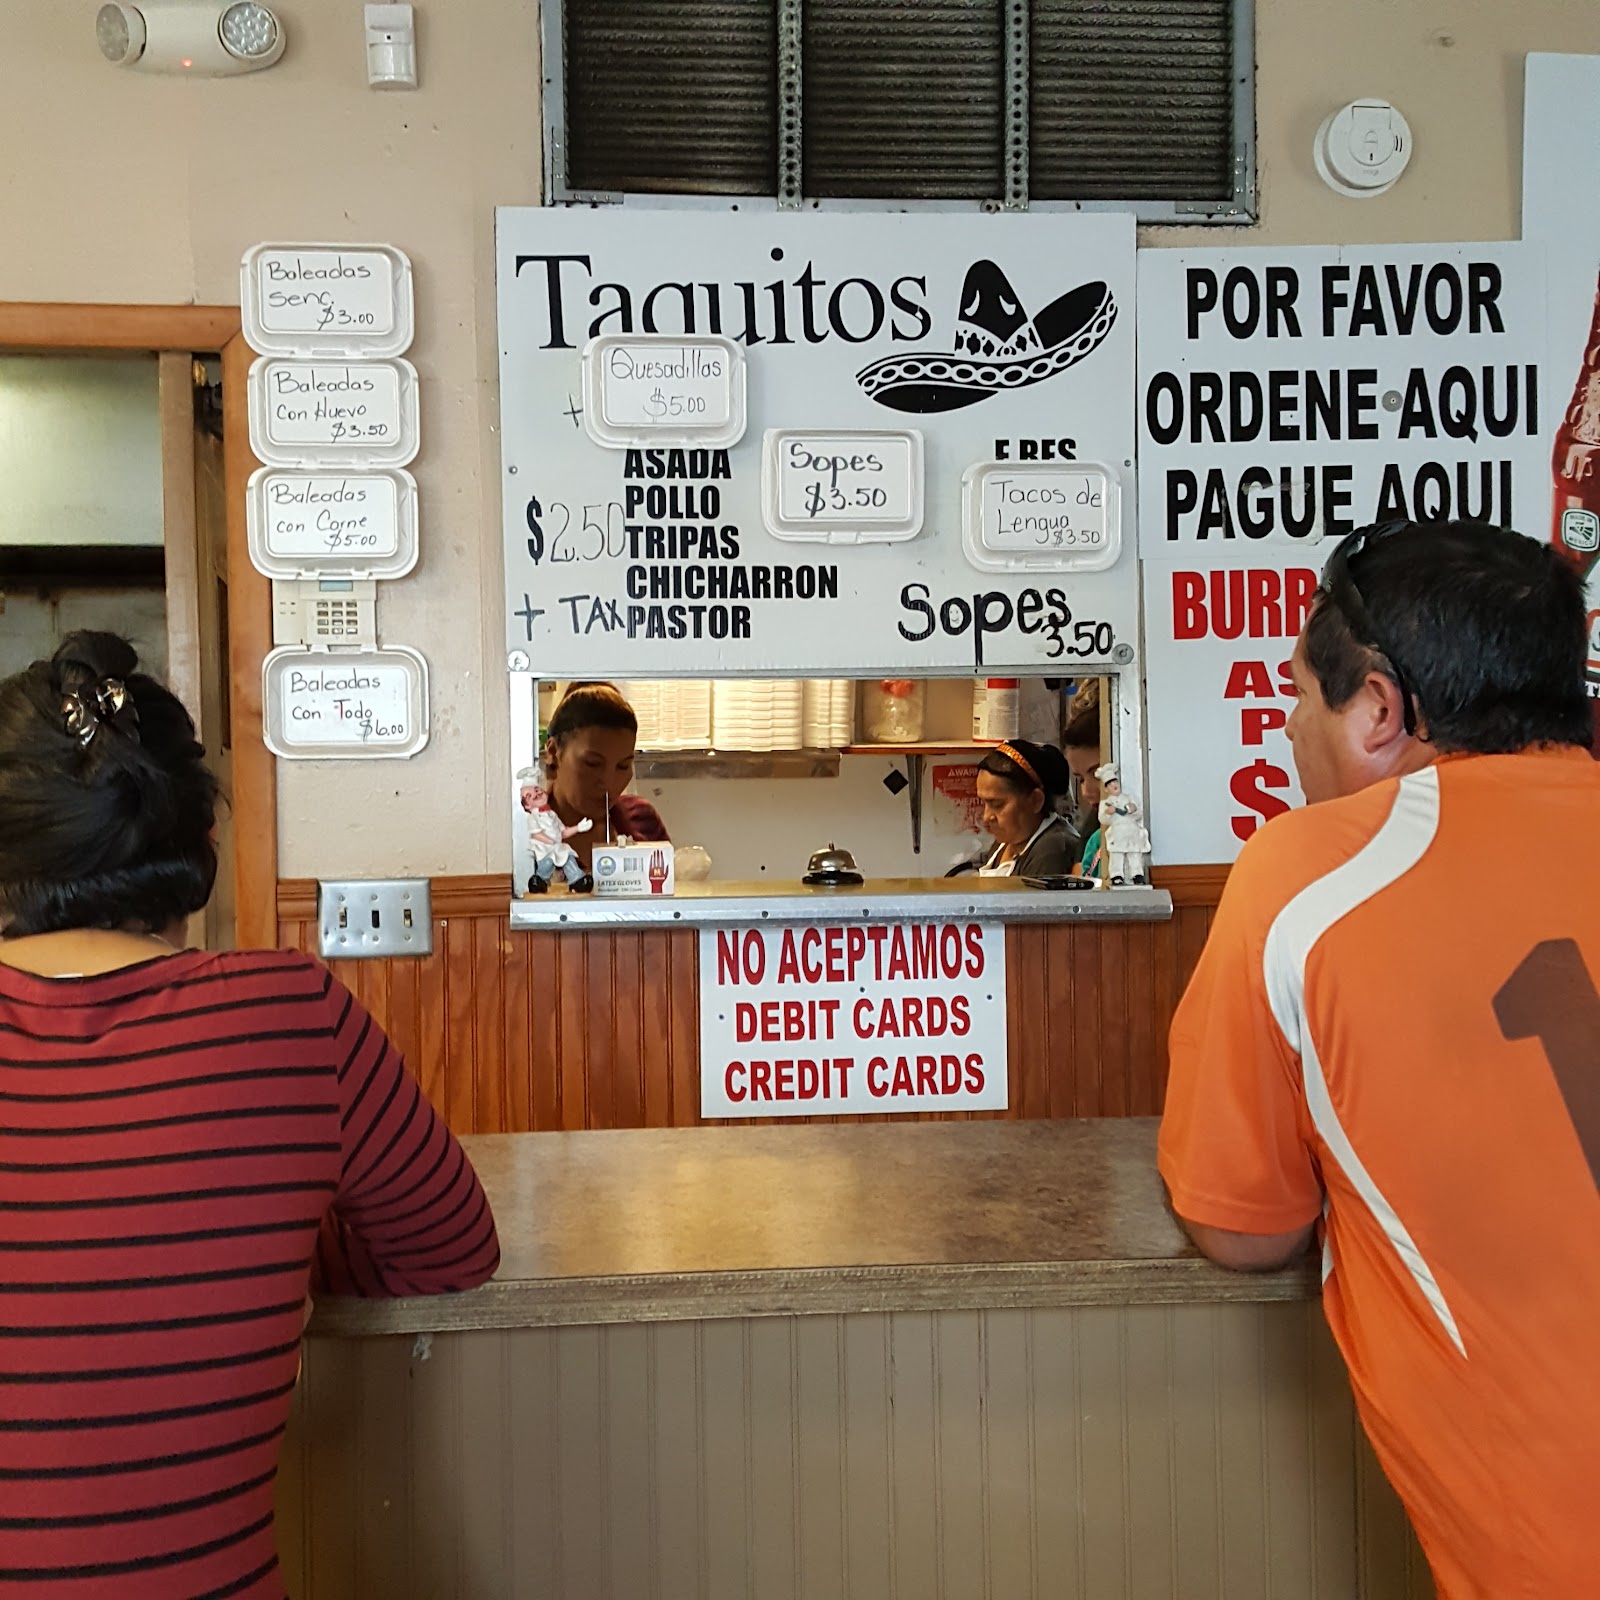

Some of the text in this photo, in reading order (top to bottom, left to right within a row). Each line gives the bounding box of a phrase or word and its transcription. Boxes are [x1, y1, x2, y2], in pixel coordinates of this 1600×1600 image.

[266, 256, 371, 280] Baleadas
[515, 247, 932, 349] Taquitos
[1186, 262, 1506, 339] POR FAVOR
[317, 306, 374, 331] $3.00
[273, 368, 375, 394] Baleadas
[611, 347, 722, 380] Quesadillas
[314, 396, 367, 421] Huevo
[643, 387, 706, 424] $5.00
[1145, 363, 1539, 446] ORDENE AQUI
[330, 421, 388, 444] $3.50
[1019, 438, 1077, 461] RES
[623, 448, 732, 479] ASADA
[790, 443, 884, 488] Sopes
[270, 480, 367, 505] Baleadas
[625, 486, 721, 519] POLLO
[804, 482, 888, 518] $3.50
[990, 478, 1102, 508] Tacos de
[1165, 460, 1513, 542] PAGUE AQUI
[323, 529, 377, 552] $5.00
[625, 525, 740, 560] TRIPAS
[997, 508, 1101, 548] Lengua $3.50
[626, 565, 839, 600] CHICHARRON
[558, 594, 626, 635] TAX
[626, 604, 751, 639] PASTOR
[1171, 567, 1318, 641] BURR
[897, 582, 1073, 667] Sopes
[1040, 620, 1114, 658] 3.50
[291, 668, 381, 693] Baleadas
[333, 698, 373, 720] Todo
[356, 719, 404, 742] $6.00
[717, 923, 986, 986] NO ACEPTAMOS
[735, 995, 972, 1043] DEBIT CARDS
[724, 1052, 986, 1103] CREDIT CARDS
